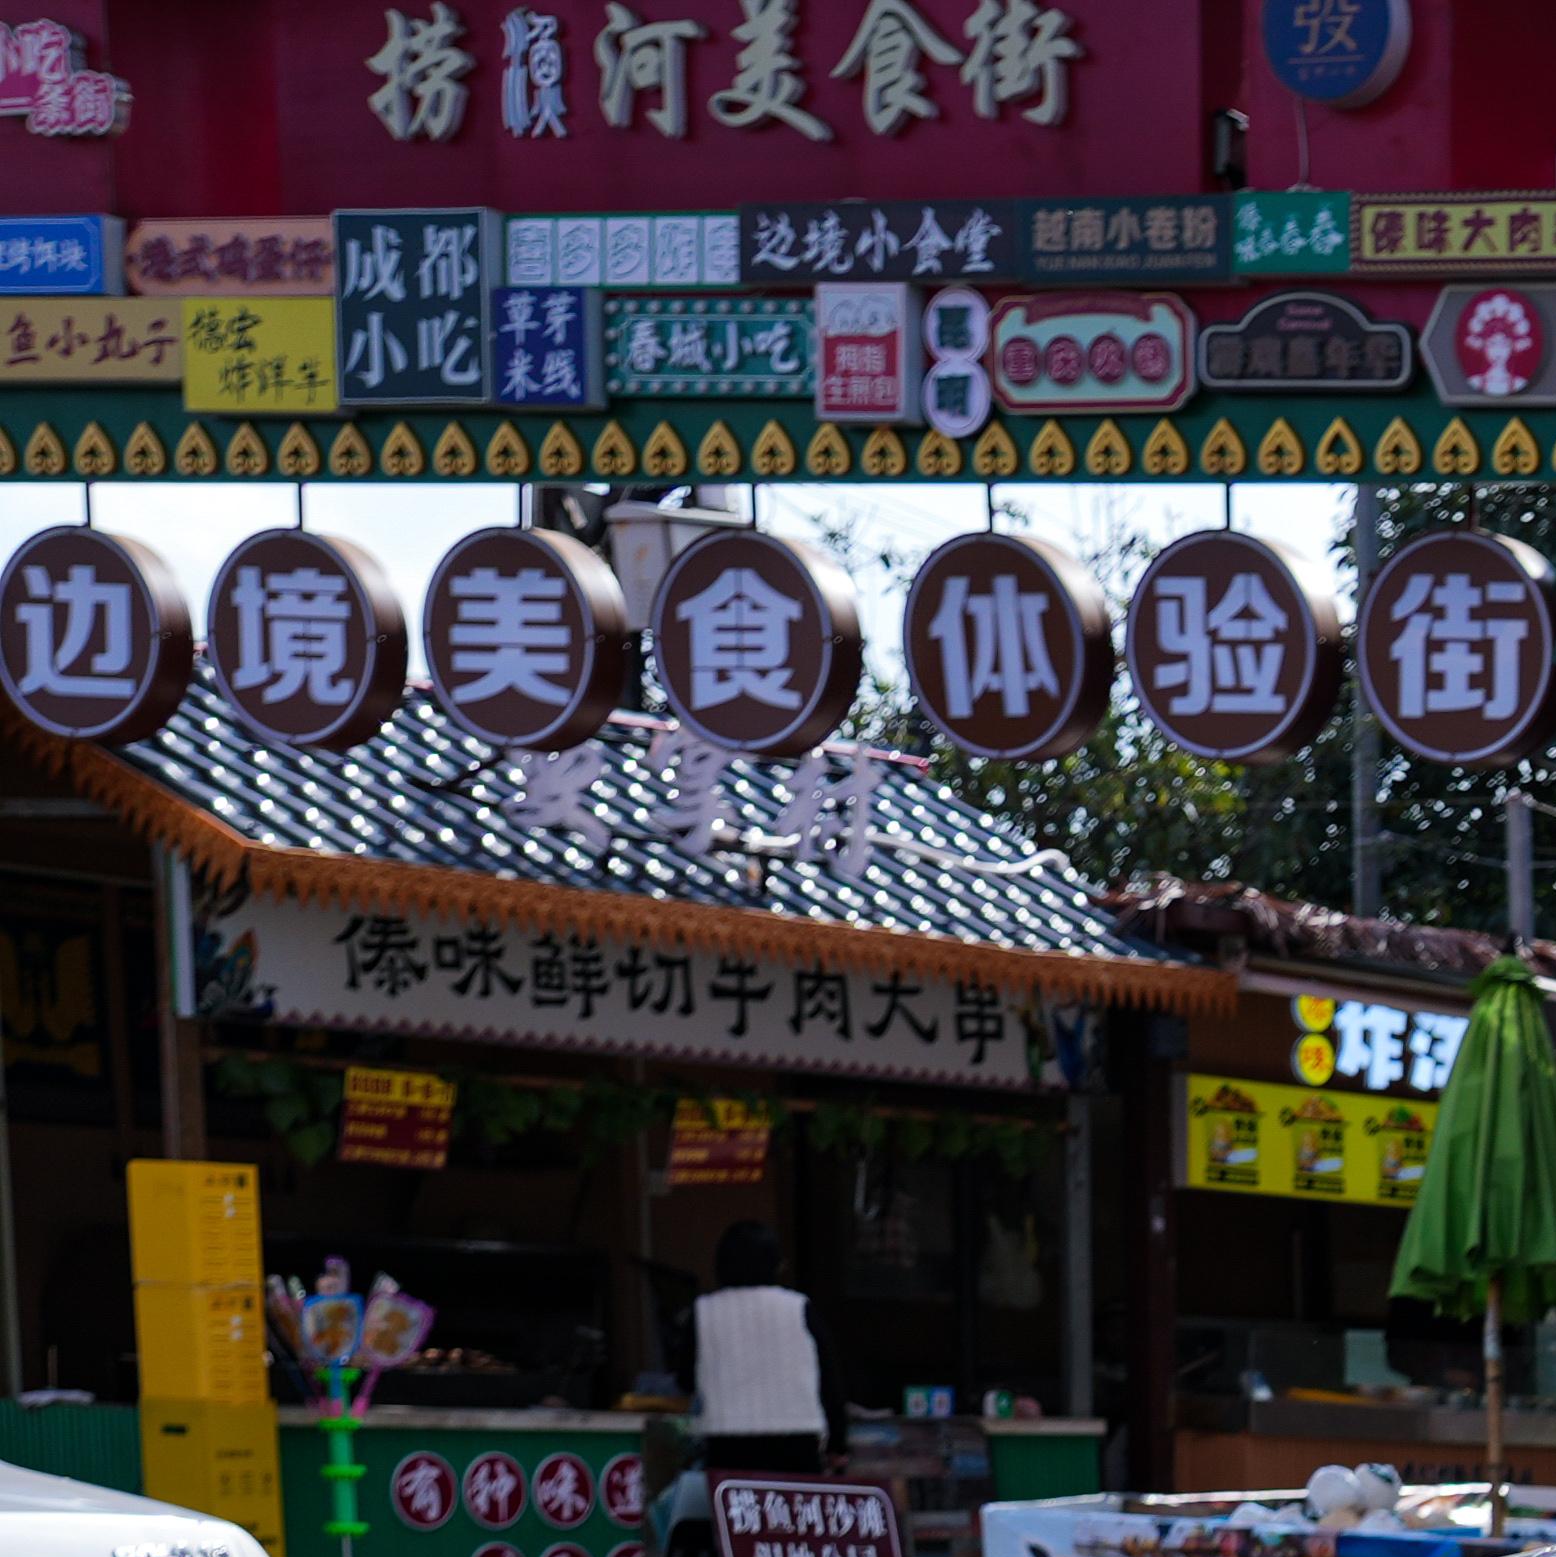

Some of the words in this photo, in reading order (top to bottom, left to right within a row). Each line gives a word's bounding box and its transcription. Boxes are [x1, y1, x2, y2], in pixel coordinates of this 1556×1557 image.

[343, 222, 481, 302] 成都
[343, 309, 481, 389] 小吃
[14, 566, 1556, 724] 边境美食体验街
